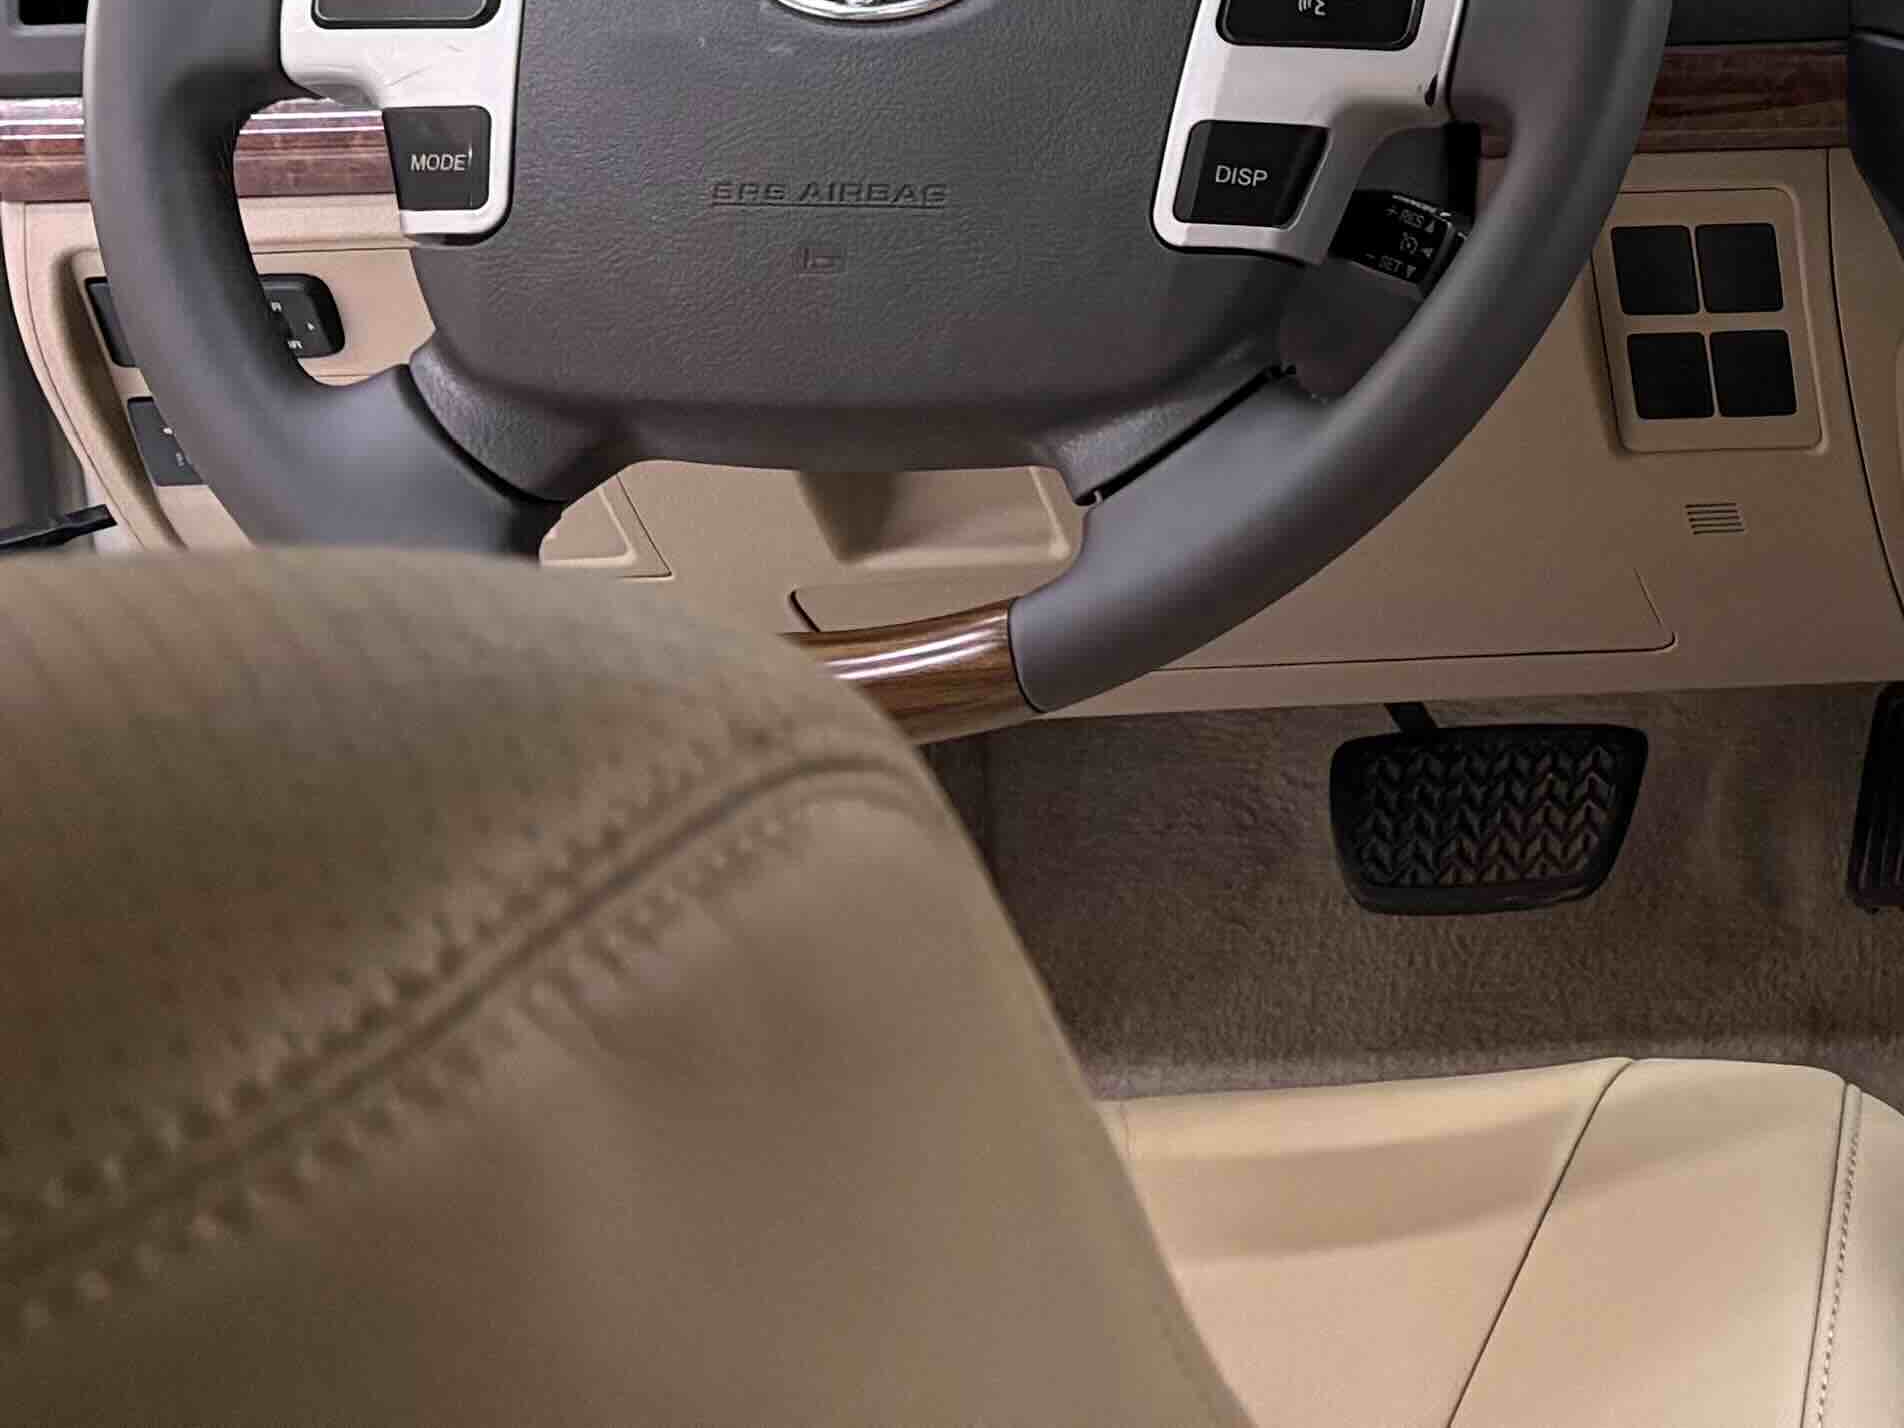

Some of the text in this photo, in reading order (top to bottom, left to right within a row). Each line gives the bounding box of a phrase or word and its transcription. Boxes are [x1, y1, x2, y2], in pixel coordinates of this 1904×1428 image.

[410, 153, 466, 172] MODE
[1215, 164, 1268, 187] DISP
[799, 183, 948, 203] AIRBAG
